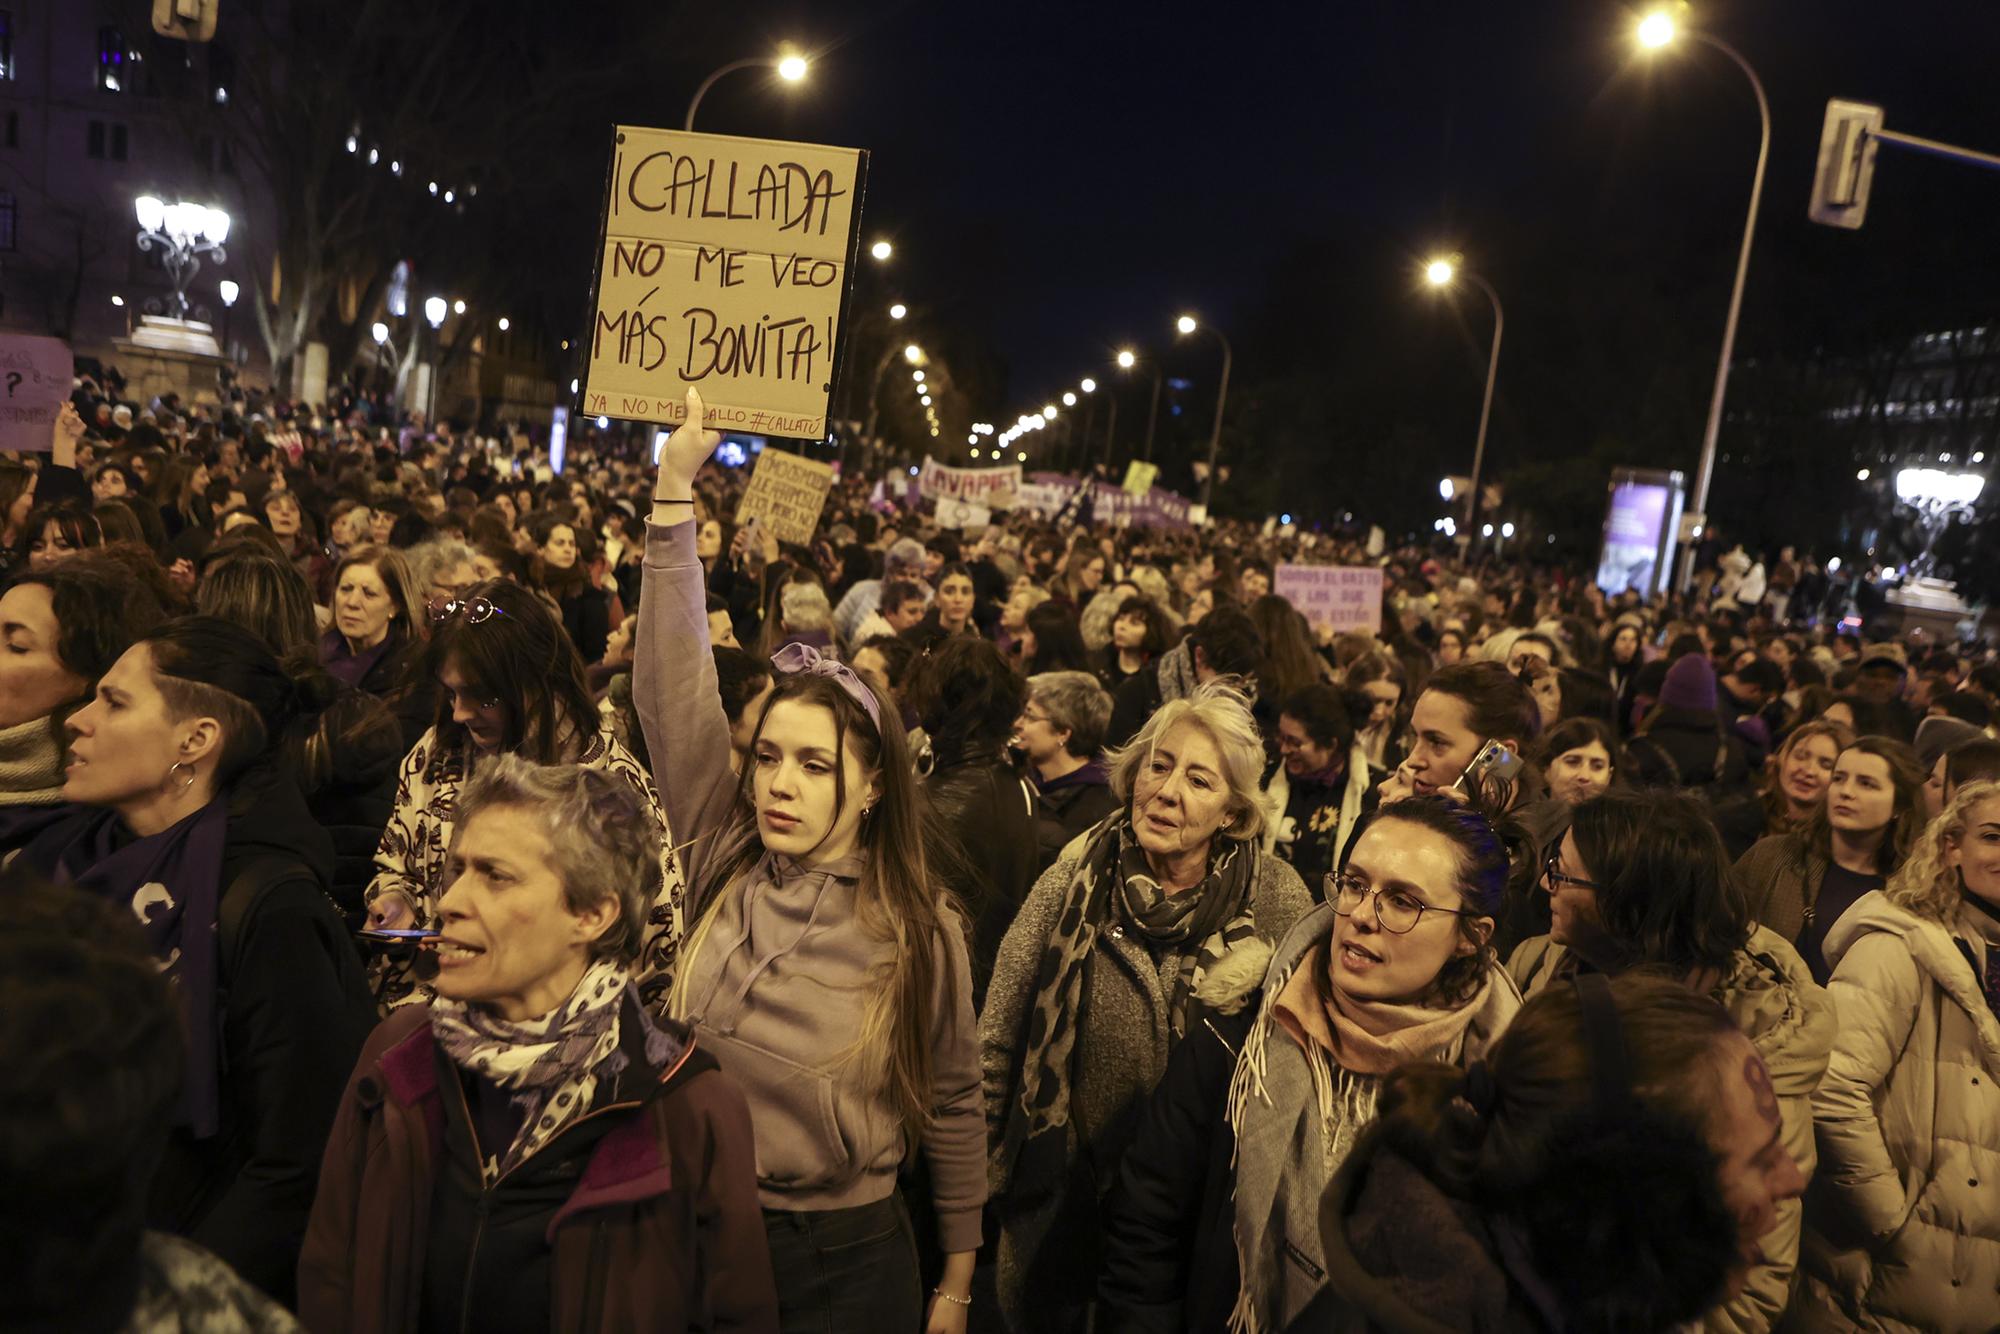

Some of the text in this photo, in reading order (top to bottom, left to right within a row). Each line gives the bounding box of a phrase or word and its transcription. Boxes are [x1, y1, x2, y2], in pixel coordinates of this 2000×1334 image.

[613, 239, 837, 288] NO ME VEO
[594, 286, 667, 372] MÁS
[590, 393, 608, 412] YA
[622, 397, 649, 415] NO
[656, 400, 687, 420] ME
[750, 410, 824, 436] #CALLATÚ
